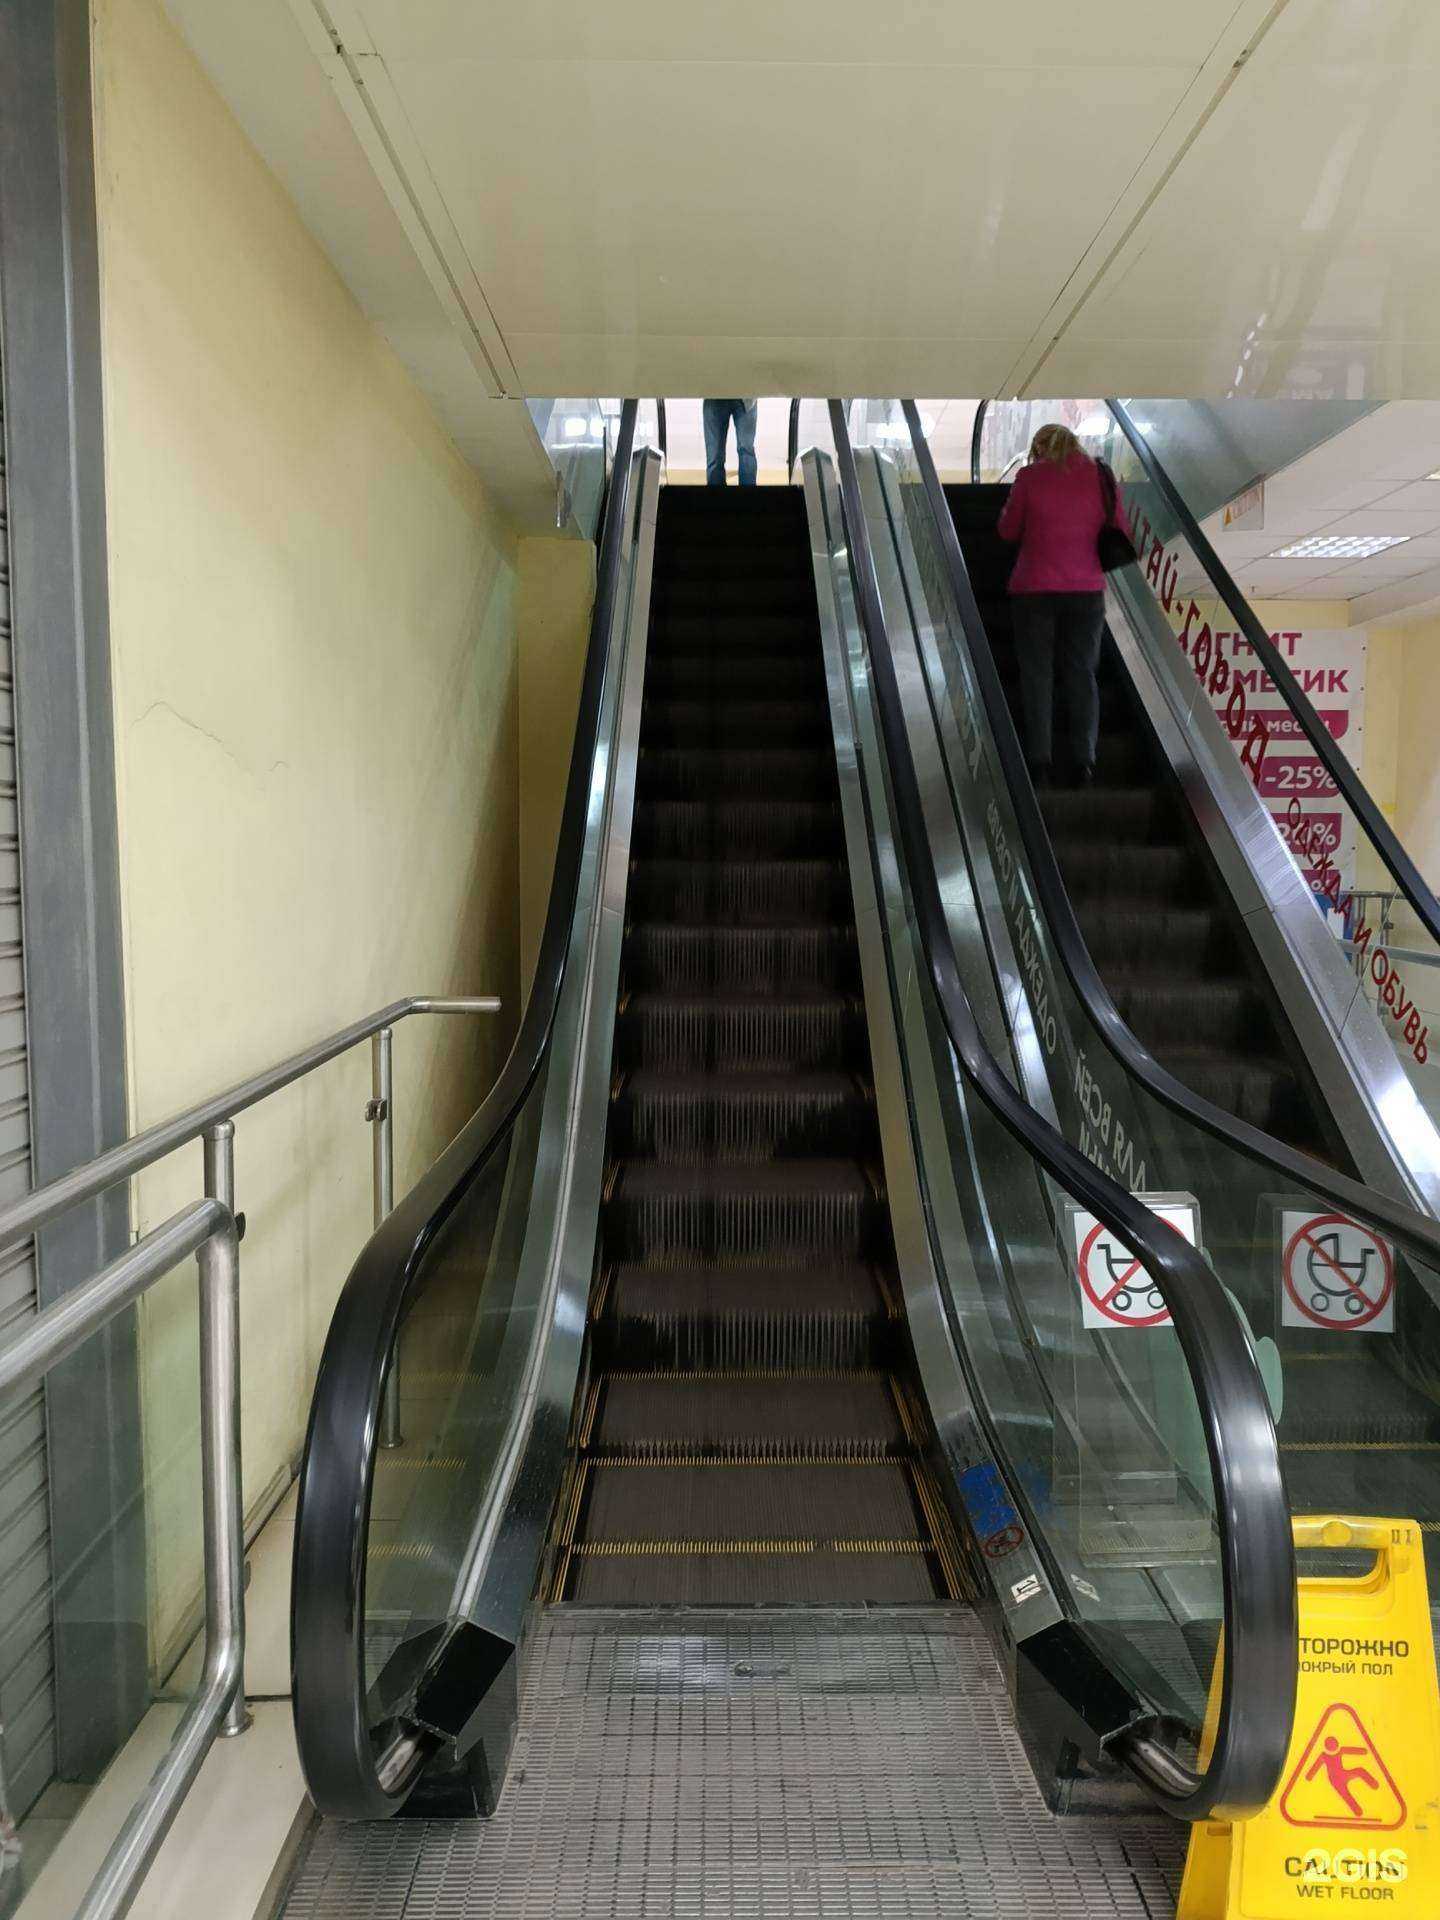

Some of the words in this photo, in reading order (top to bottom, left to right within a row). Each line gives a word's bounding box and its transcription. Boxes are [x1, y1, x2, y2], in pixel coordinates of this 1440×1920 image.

[1265, 766, 1338, 789] -25%
[1371, 948, 1428, 1064] ОБУВЬ
[1298, 1660, 1356, 1674] ОКРЫЙ
[1361, 1662, 1393, 1676] ПОЛ
[1296, 1883, 1334, 1899] WET
[1340, 1886, 1395, 1901] FLOOR
